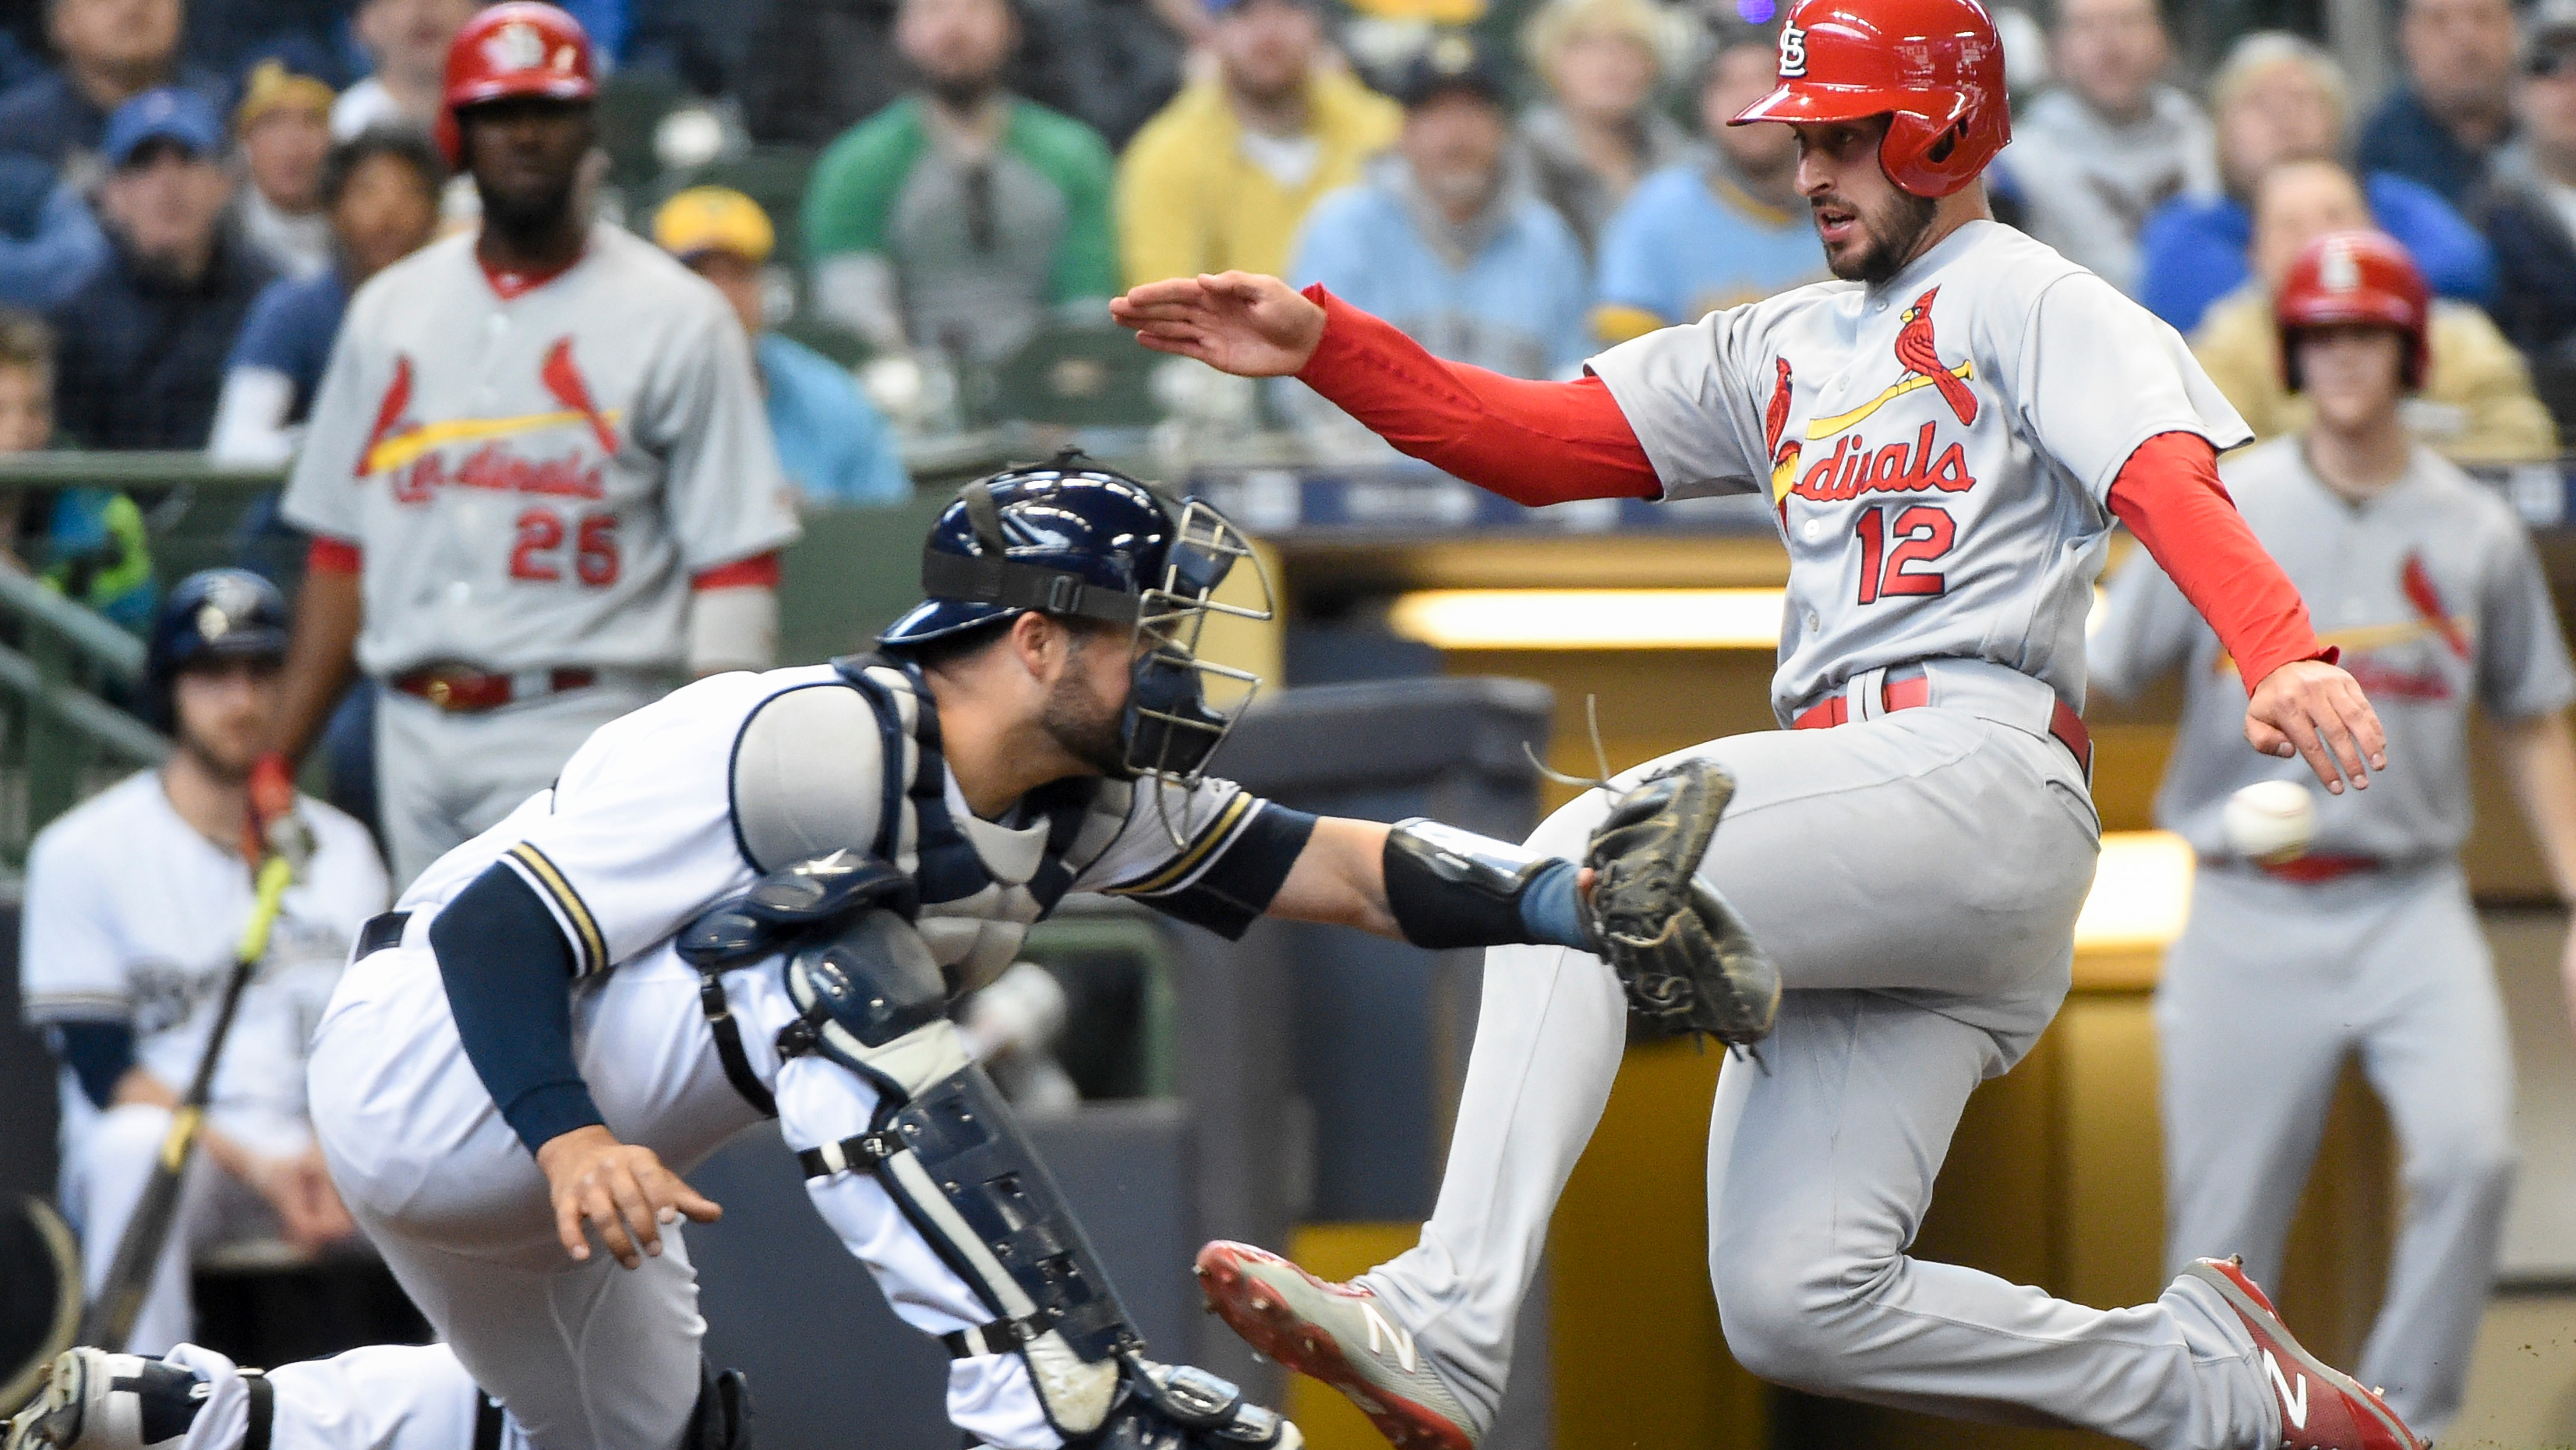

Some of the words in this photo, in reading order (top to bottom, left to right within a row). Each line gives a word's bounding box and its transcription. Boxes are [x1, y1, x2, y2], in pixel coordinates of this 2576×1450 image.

[511, 507, 620, 588] 25
[1855, 504, 1957, 606] 12
[1359, 1300, 1416, 1374] N
[2263, 1347, 2308, 1430] N
